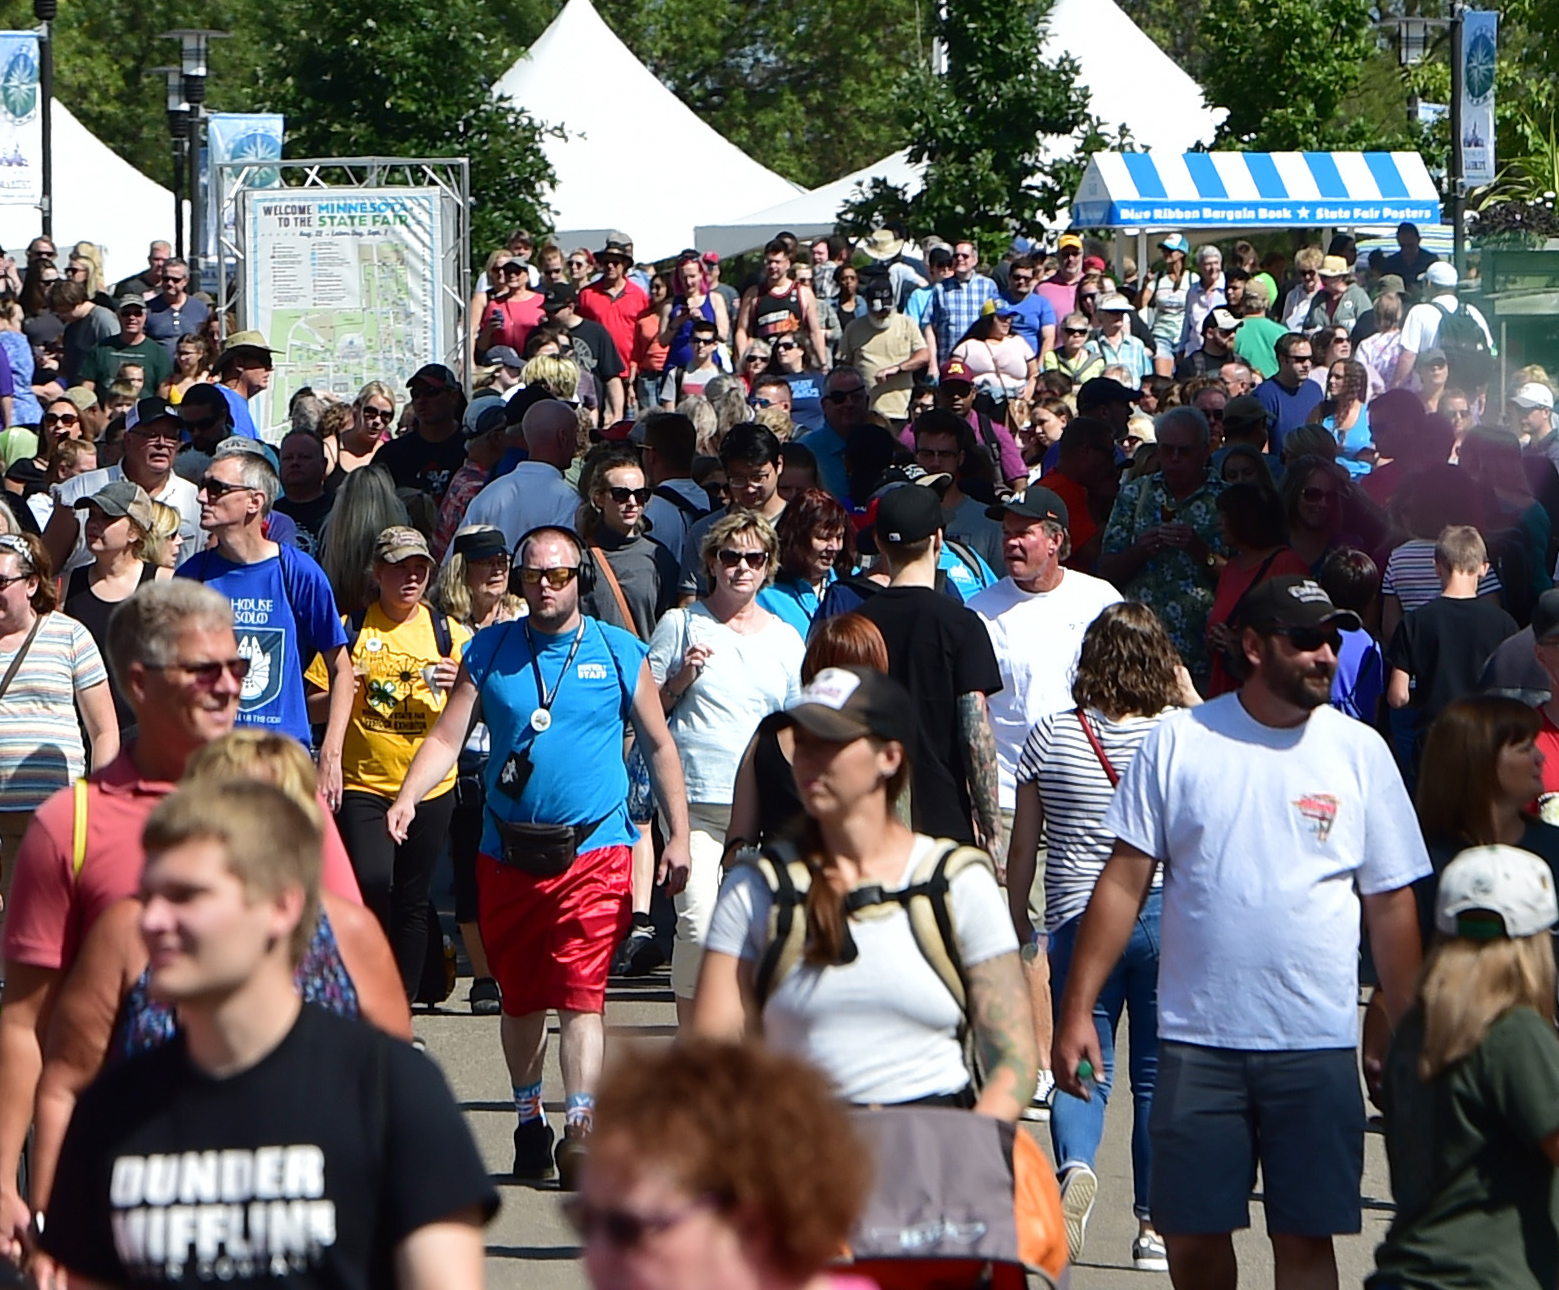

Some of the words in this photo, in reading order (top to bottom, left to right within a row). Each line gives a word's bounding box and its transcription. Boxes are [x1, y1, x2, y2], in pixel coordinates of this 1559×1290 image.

[262, 203, 313, 216] WELCOME
[1120, 207, 1151, 220] Blue
[1153, 207, 1200, 220] Ribbon
[1203, 207, 1255, 222] Bargain
[1258, 207, 1292, 220] Book
[1316, 207, 1351, 220] State
[1353, 207, 1380, 220] Fair
[1383, 207, 1432, 220] Posters
[277, 216, 290, 228] TO
[293, 216, 313, 227] THE
[317, 214, 368, 227] STATE
[371, 214, 409, 227] FAIR
[230, 597, 274, 612] HOUSE
[234, 610, 269, 624] SOLO
[110, 1144, 325, 1209] DUNDER
